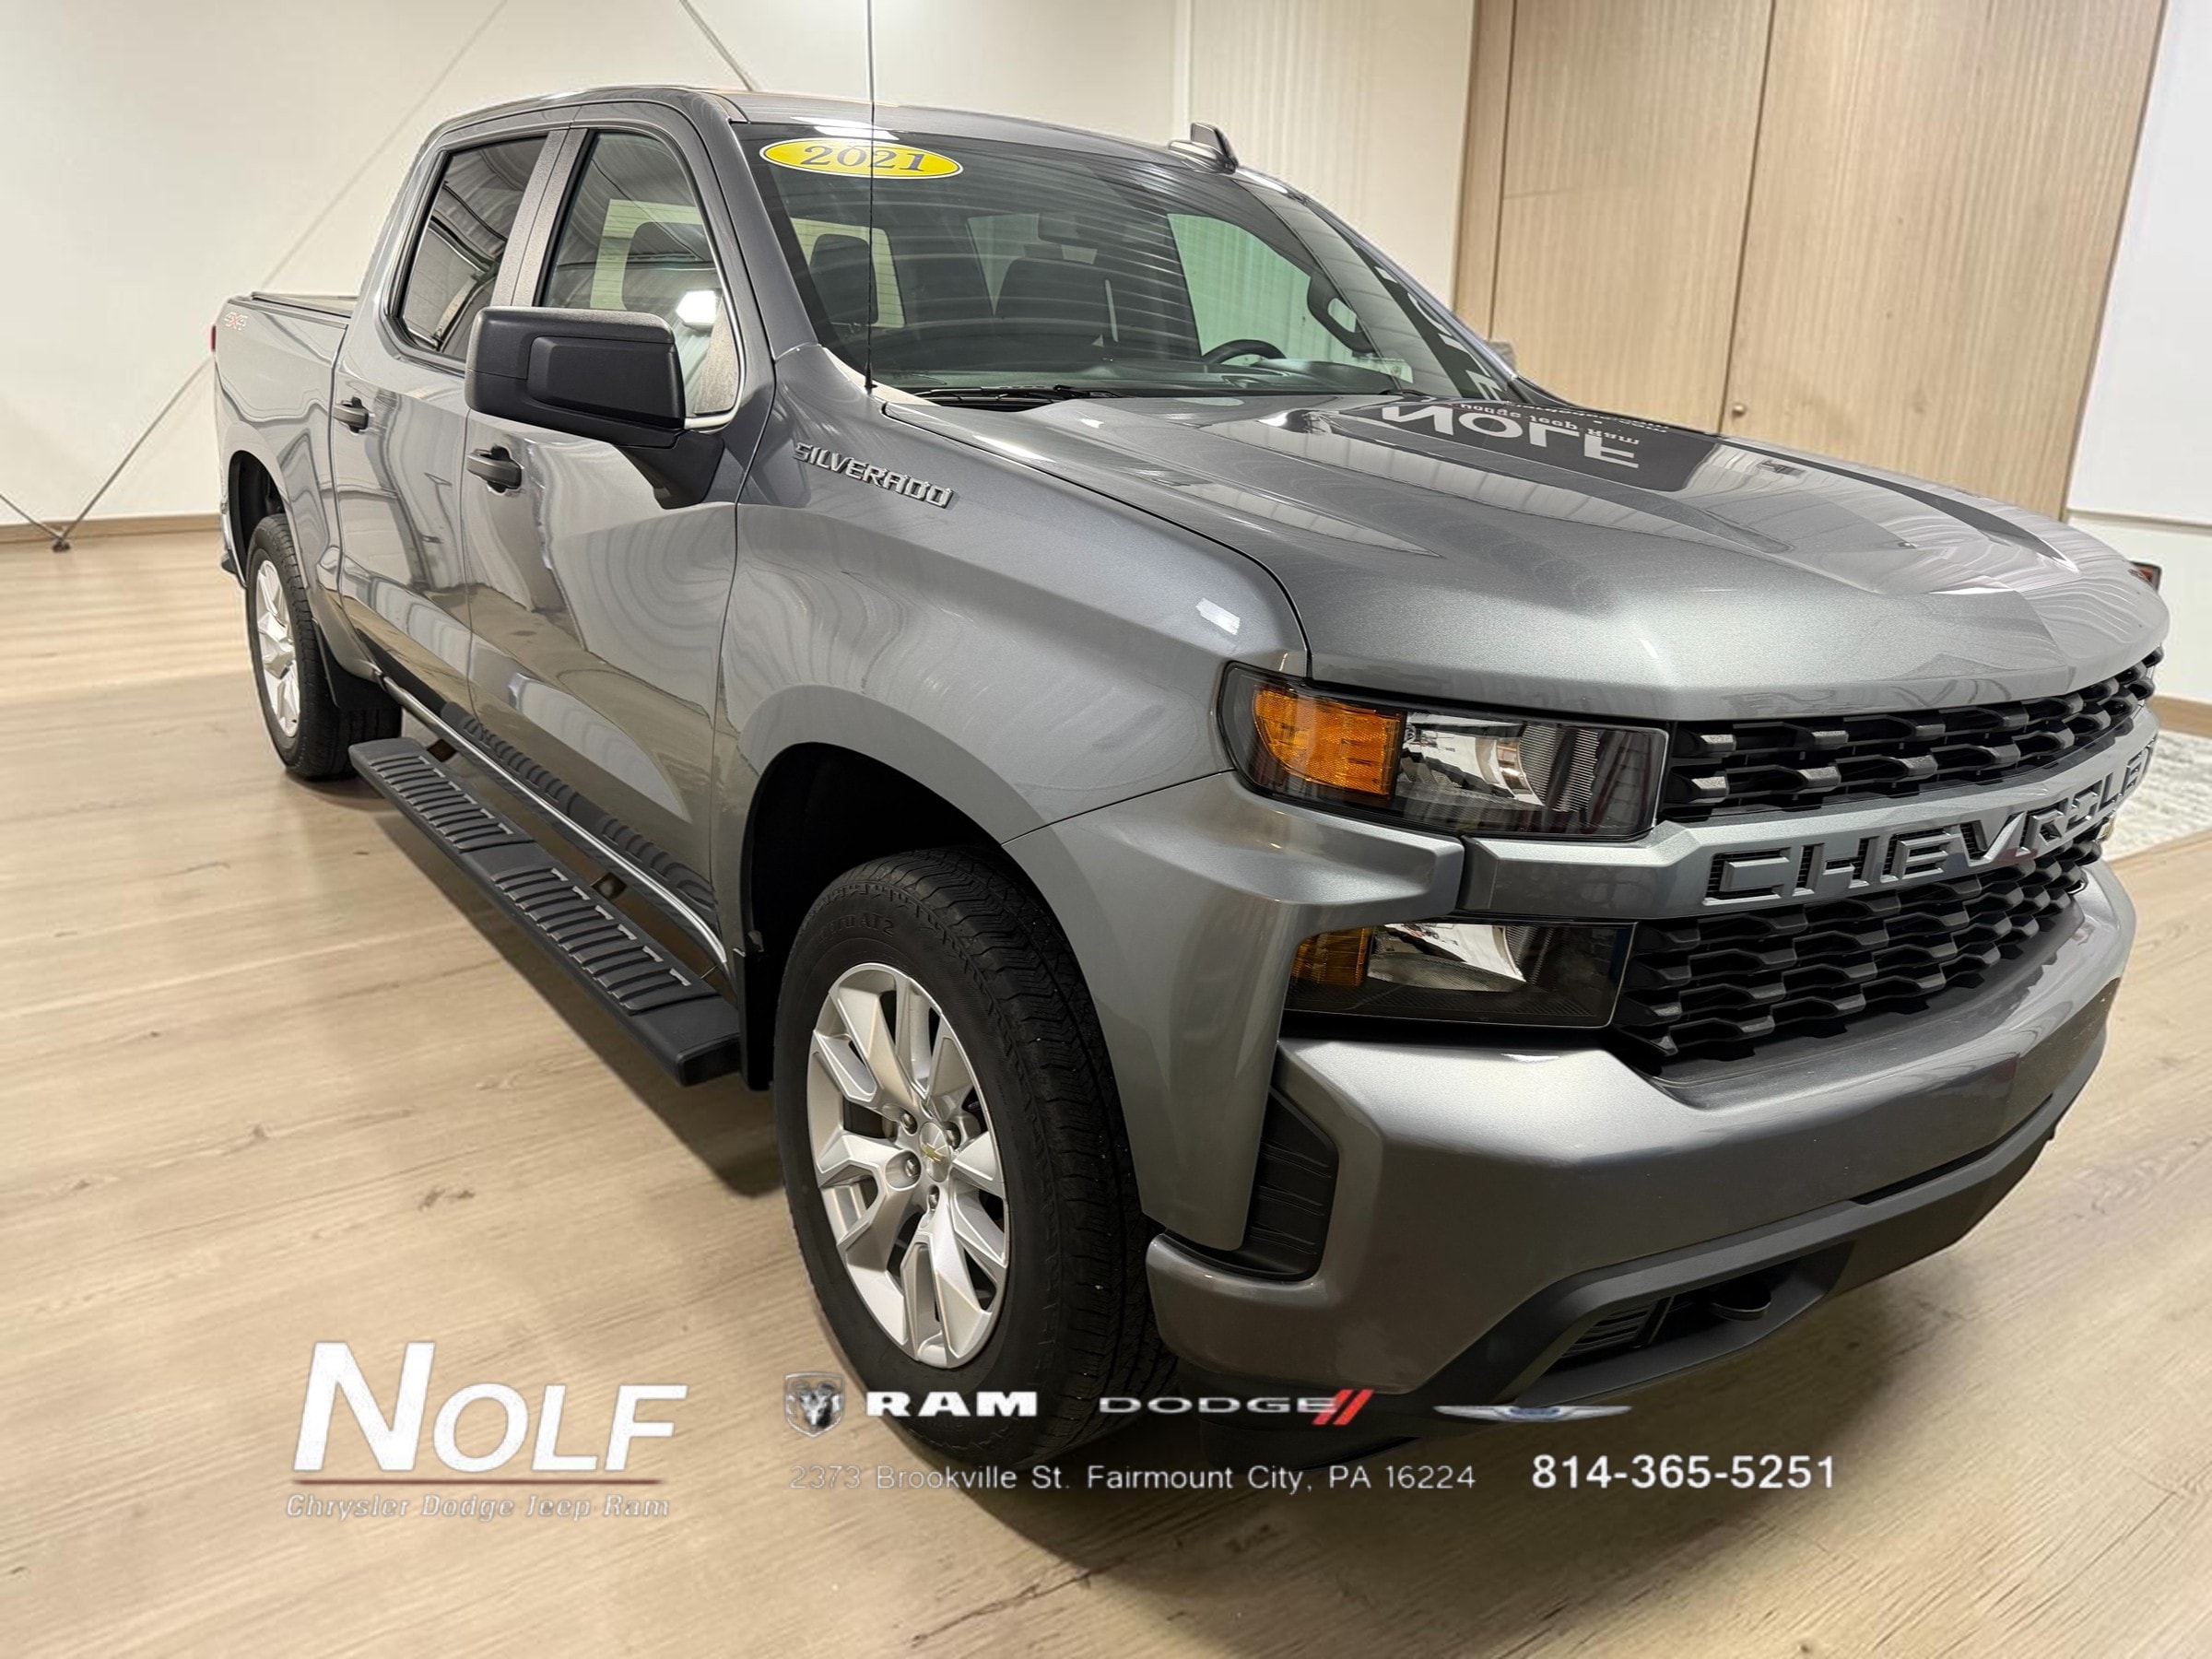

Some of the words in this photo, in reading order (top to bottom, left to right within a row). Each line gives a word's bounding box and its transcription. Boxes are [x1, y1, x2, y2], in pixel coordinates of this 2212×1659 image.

[800, 145, 925, 172] 2021
[794, 441, 955, 509] SILVERADO
[1702, 735, 2157, 907] CHEVROLET
